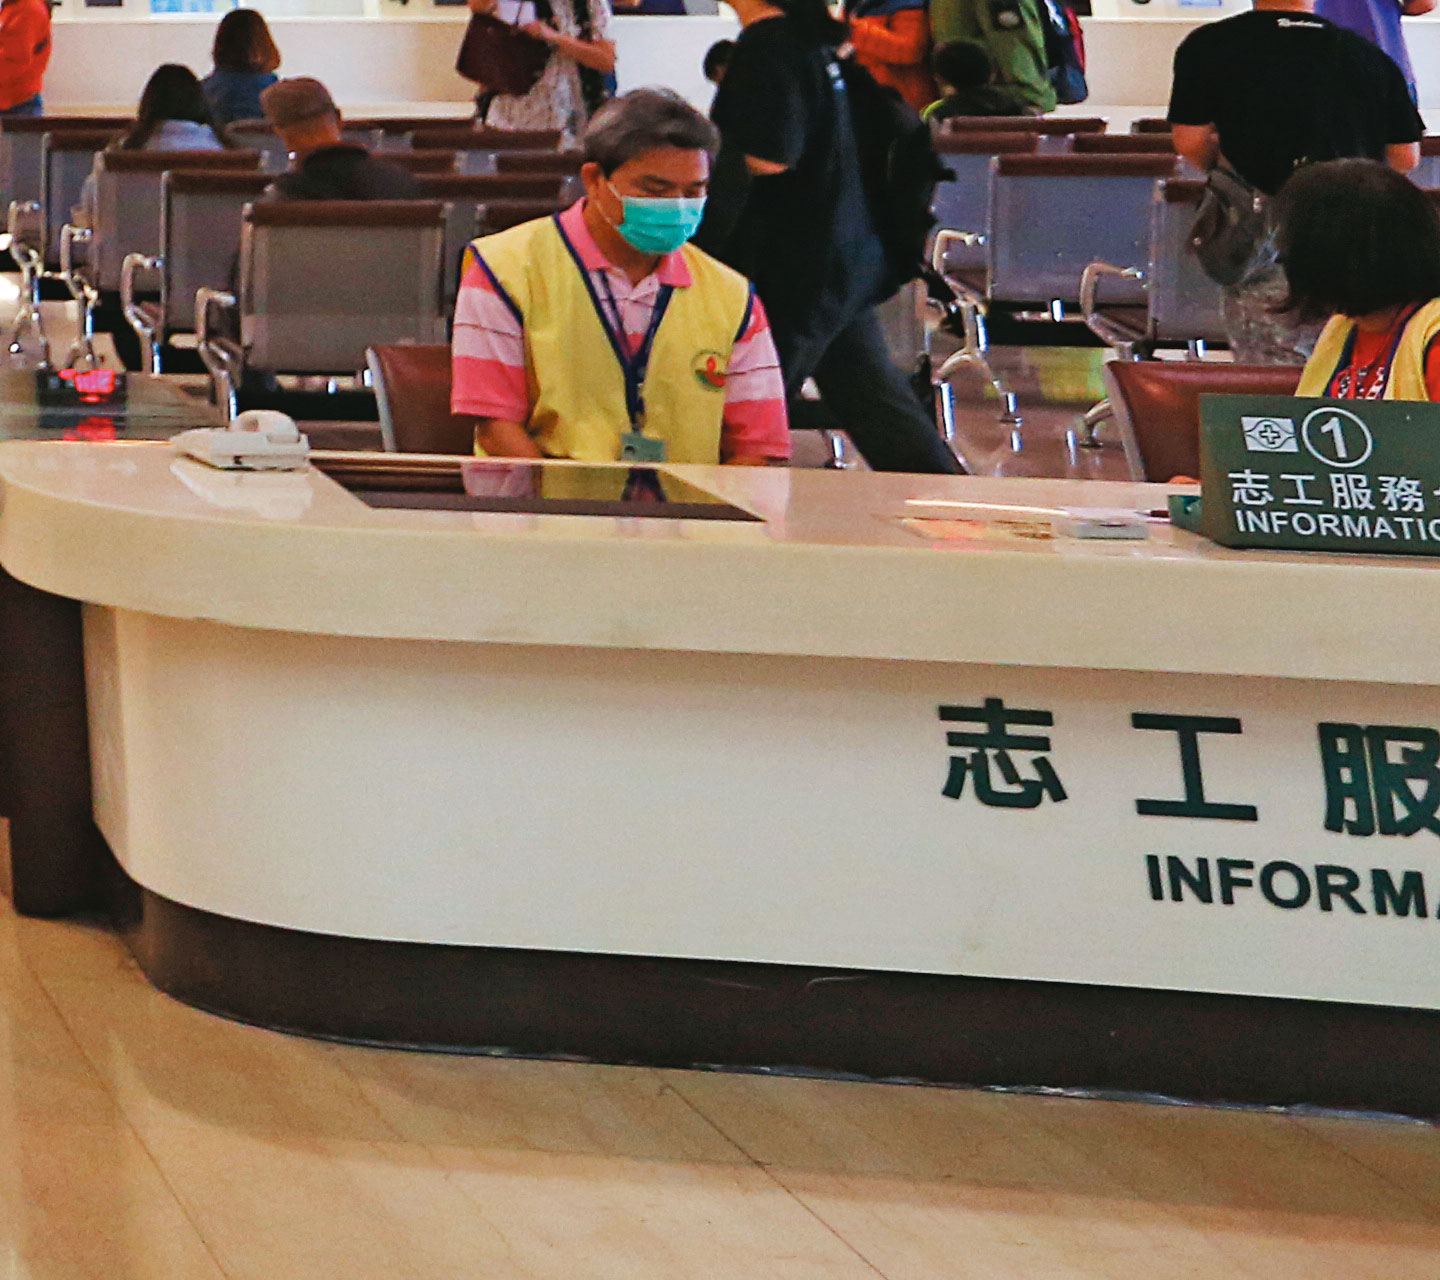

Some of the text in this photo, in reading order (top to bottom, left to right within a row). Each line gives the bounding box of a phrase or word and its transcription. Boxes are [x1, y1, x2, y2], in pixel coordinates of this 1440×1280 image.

[1228, 469, 1440, 513] 志工服務
[938, 697, 1440, 837] 志工服
[1145, 852, 1440, 919] INFORM
